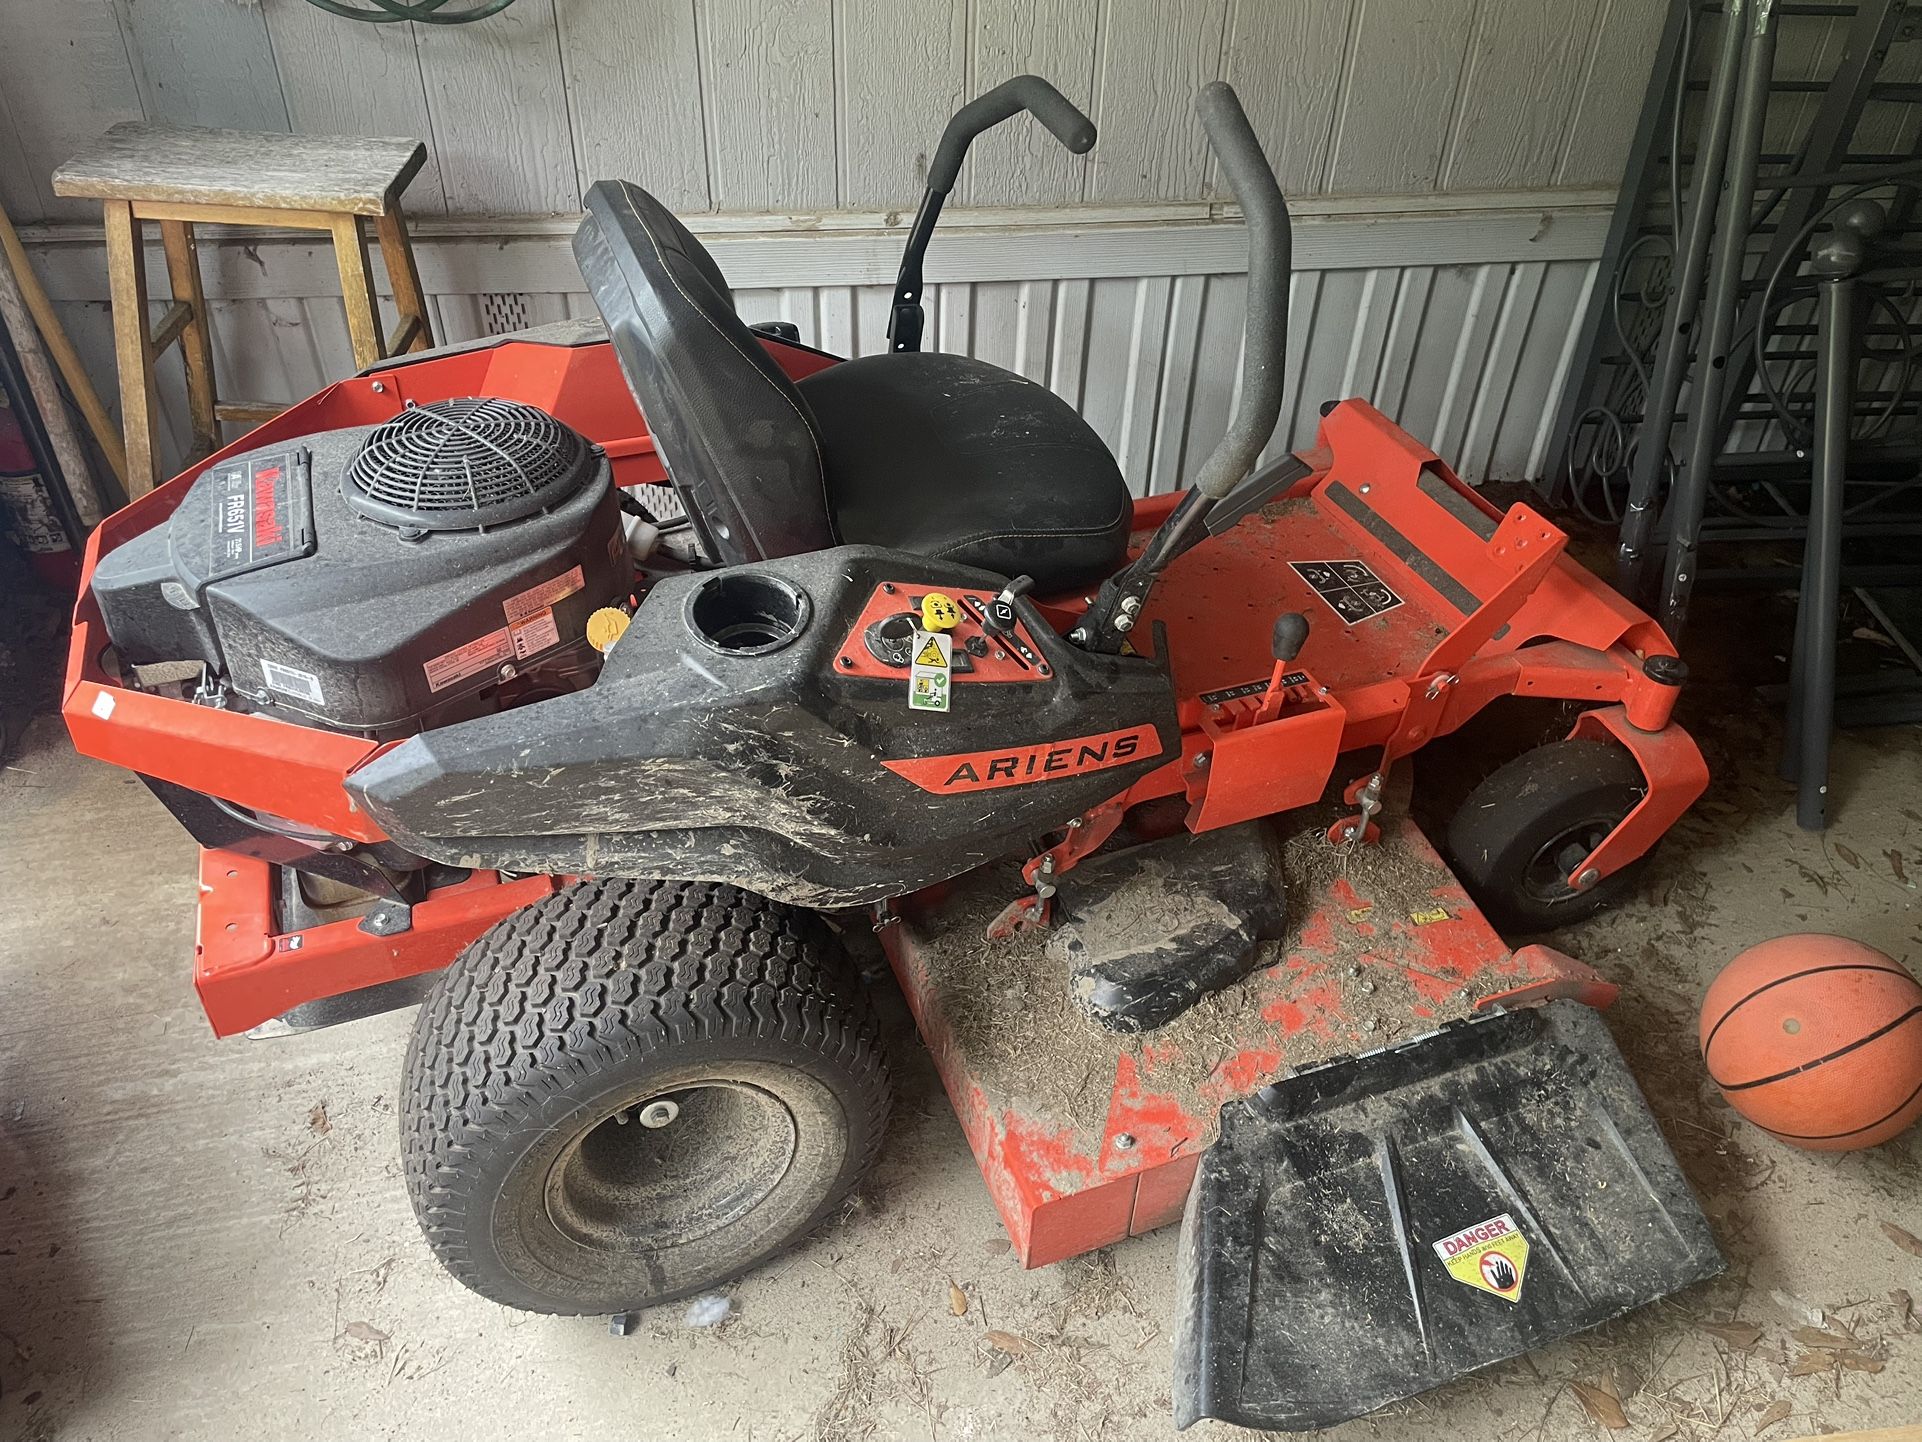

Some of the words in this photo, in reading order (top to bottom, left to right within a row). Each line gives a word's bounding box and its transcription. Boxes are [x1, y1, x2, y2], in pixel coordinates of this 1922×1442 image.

[227, 494, 245, 533] FR651V
[255, 466, 283, 548] Kawasaki
[943, 734, 1140, 786] ARIENS
[1443, 1219, 1511, 1256] DANGER
[1447, 1257, 1463, 1266] KEEP
[1462, 1246, 1482, 1260] HANDS
[1492, 1238, 1505, 1248] FEET
[1505, 1233, 1520, 1242] AWAY
